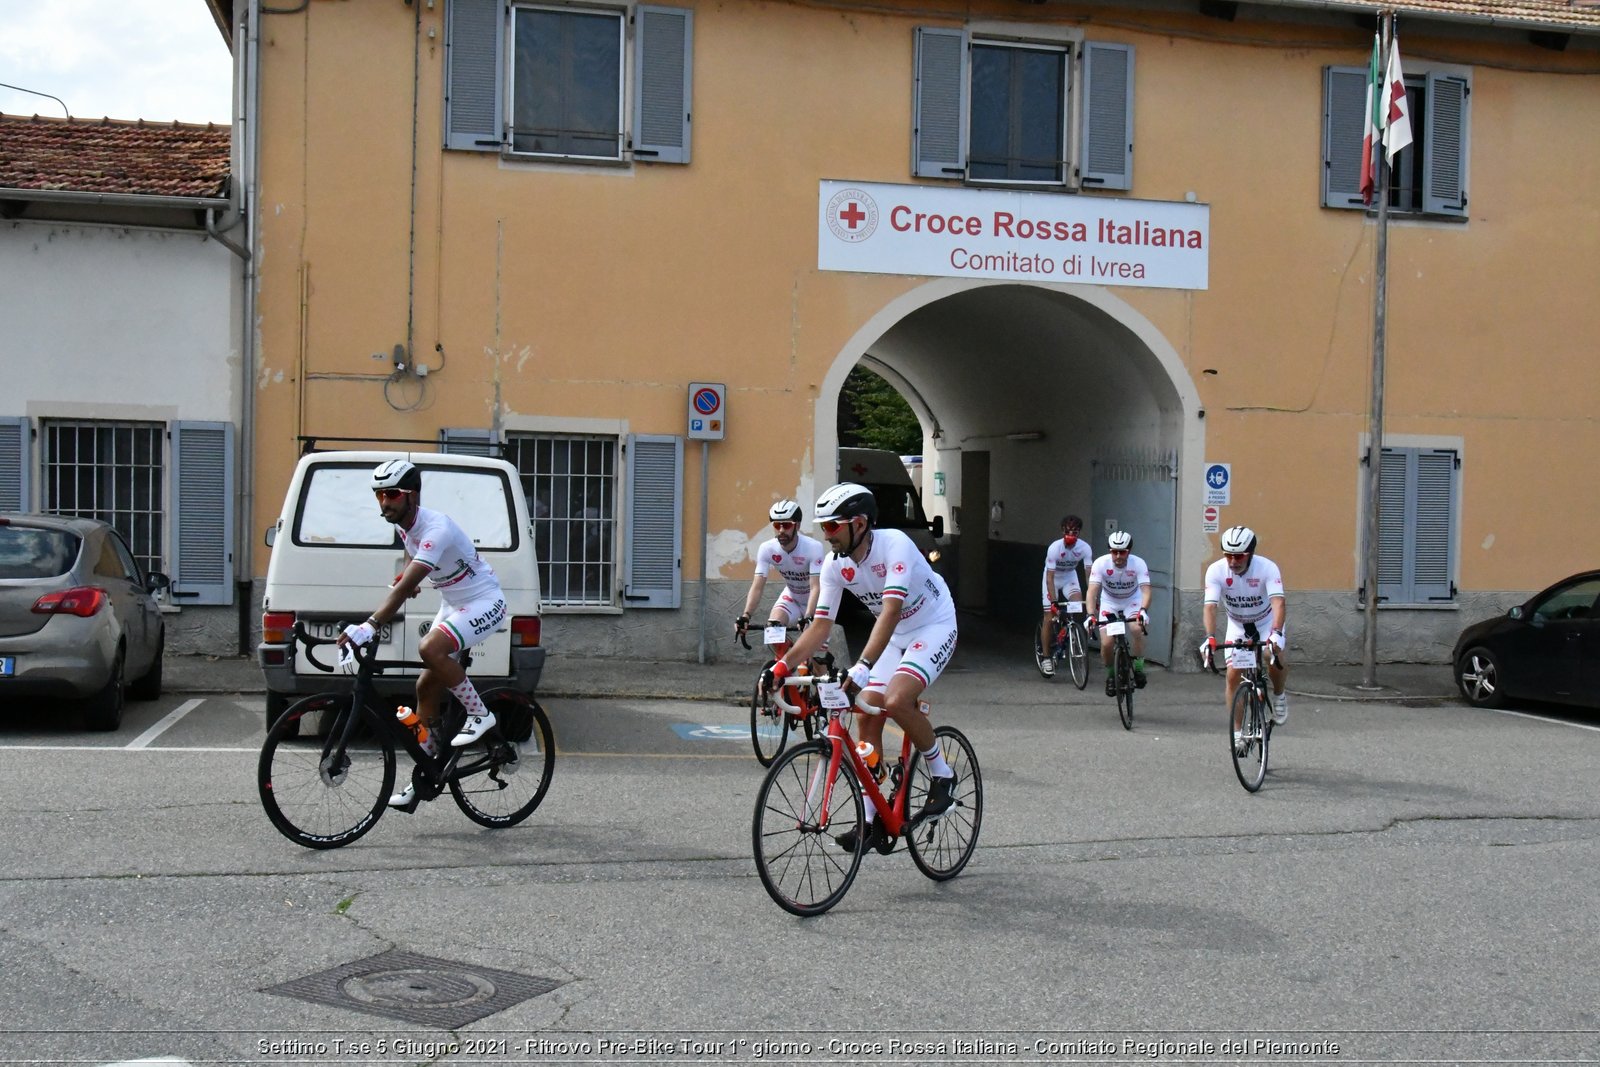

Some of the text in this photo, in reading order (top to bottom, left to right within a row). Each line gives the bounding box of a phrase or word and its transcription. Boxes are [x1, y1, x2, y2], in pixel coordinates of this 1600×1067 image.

[890, 205, 1202, 249] Croce Rossa Italiana
[950, 247, 1146, 279] Comitato di Ivrea
[693, 420, 702, 430] P
[1225, 594, 1262, 602] Un'Italia
[1240, 600, 1264, 609] aiuta
[468, 599, 504, 628] Un'Italia
[474, 624, 491, 635] che
[930, 629, 957, 665] Un'Italia
[299, 813, 373, 842] FULCRUM
